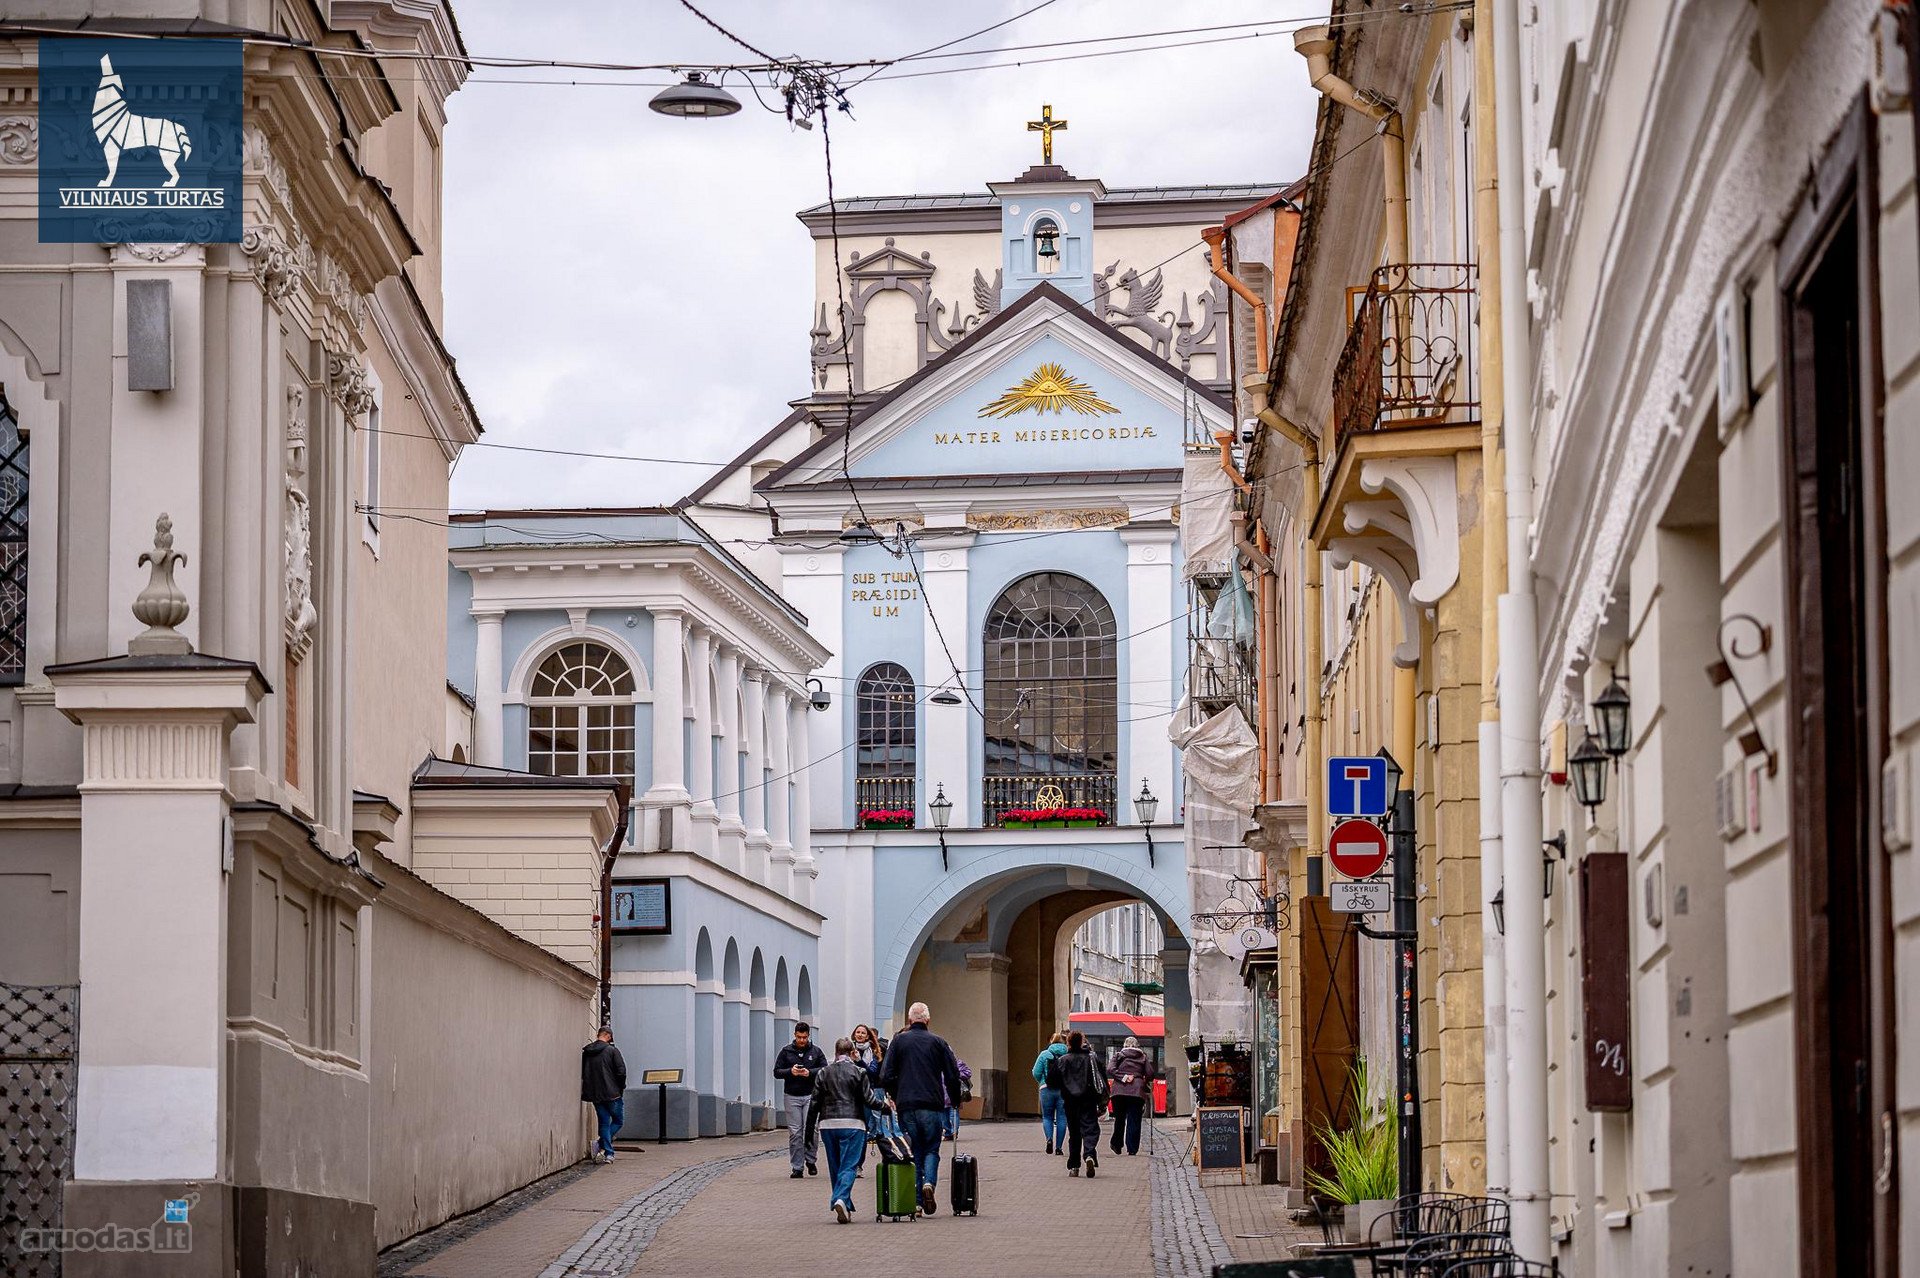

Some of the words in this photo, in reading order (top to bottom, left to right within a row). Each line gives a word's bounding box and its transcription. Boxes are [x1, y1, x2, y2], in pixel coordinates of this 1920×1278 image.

[935, 431, 1000, 445] MATER
[1015, 426, 1158, 442] MISERICORDIÆ
[852, 572, 876, 584] SUB
[1341, 884, 1379, 893] IŠSKYRUS
[1202, 1126, 1238, 1134] CRYSTAL
[1207, 1134, 1231, 1143] SHOP
[1204, 1144, 1228, 1152] OPEN
